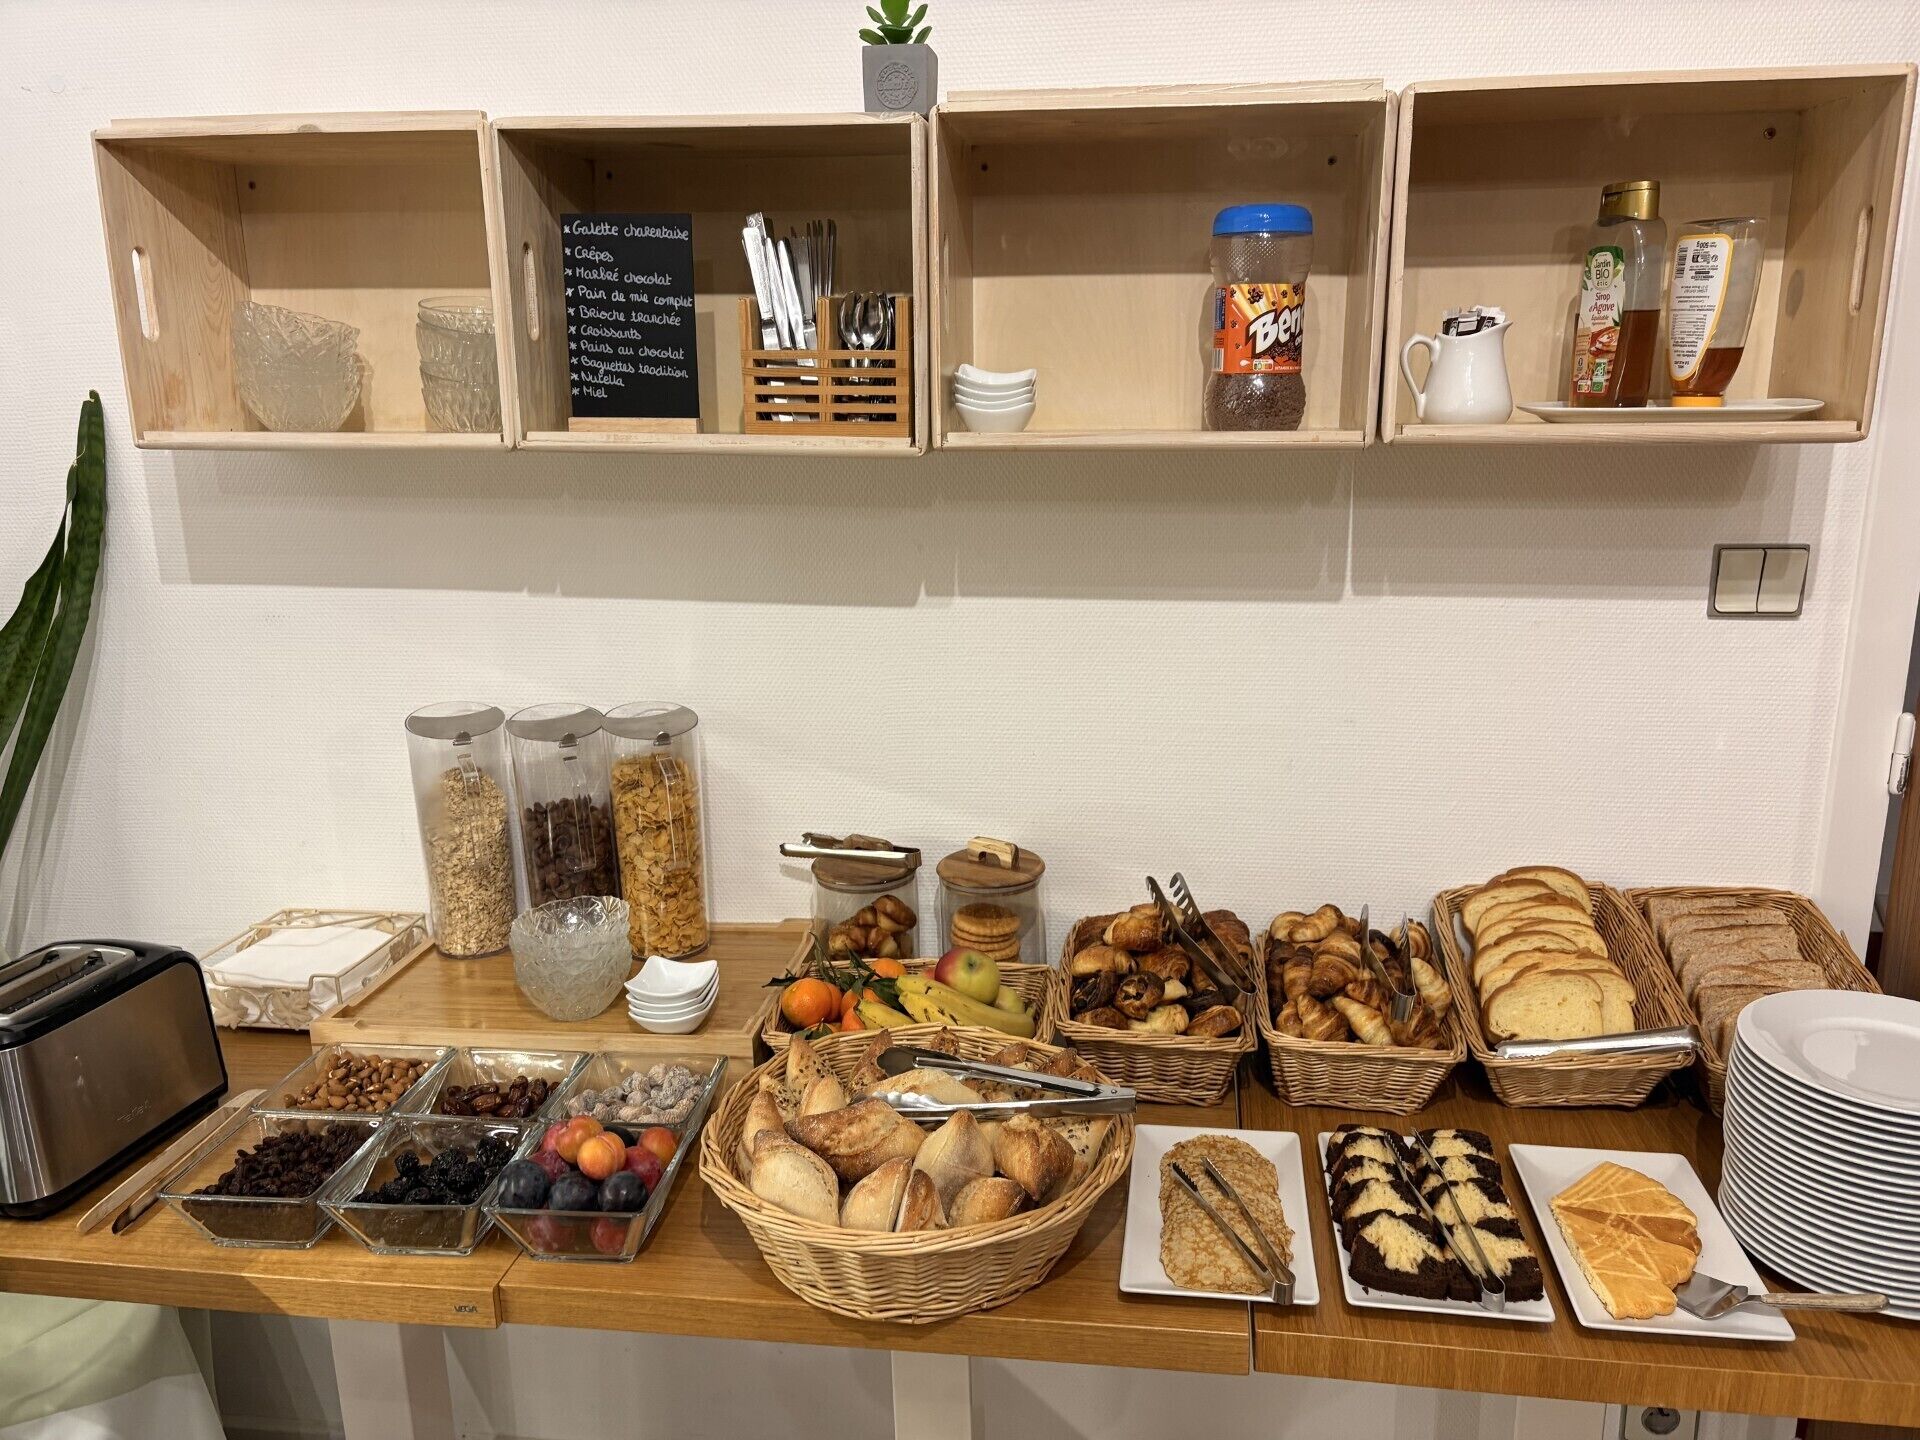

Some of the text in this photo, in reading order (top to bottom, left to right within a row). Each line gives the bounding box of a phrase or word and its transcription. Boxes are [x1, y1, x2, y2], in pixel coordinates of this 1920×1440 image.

[573, 220, 689, 240] Galette charentaise
[575, 246, 614, 263] Crêpes
[1594, 259, 1611, 269] Jardin
[575, 267, 672, 285] Marbré chocolat
[1595, 268, 1610, 280] BIO
[578, 285, 693, 310] Pain de mie complet
[1596, 292, 1611, 302] Sirop
[579, 305, 681, 326] Brioche tranchée
[580, 324, 642, 339] Croissants
[1249, 305, 1304, 355] Ben
[580, 340, 684, 360] Pains au chocolat
[581, 356, 689, 378] Baguettes tradition
[581, 371, 625, 387] Nutella
[583, 386, 608, 398] Miel
[454, 1305, 478, 1313] VEGA
